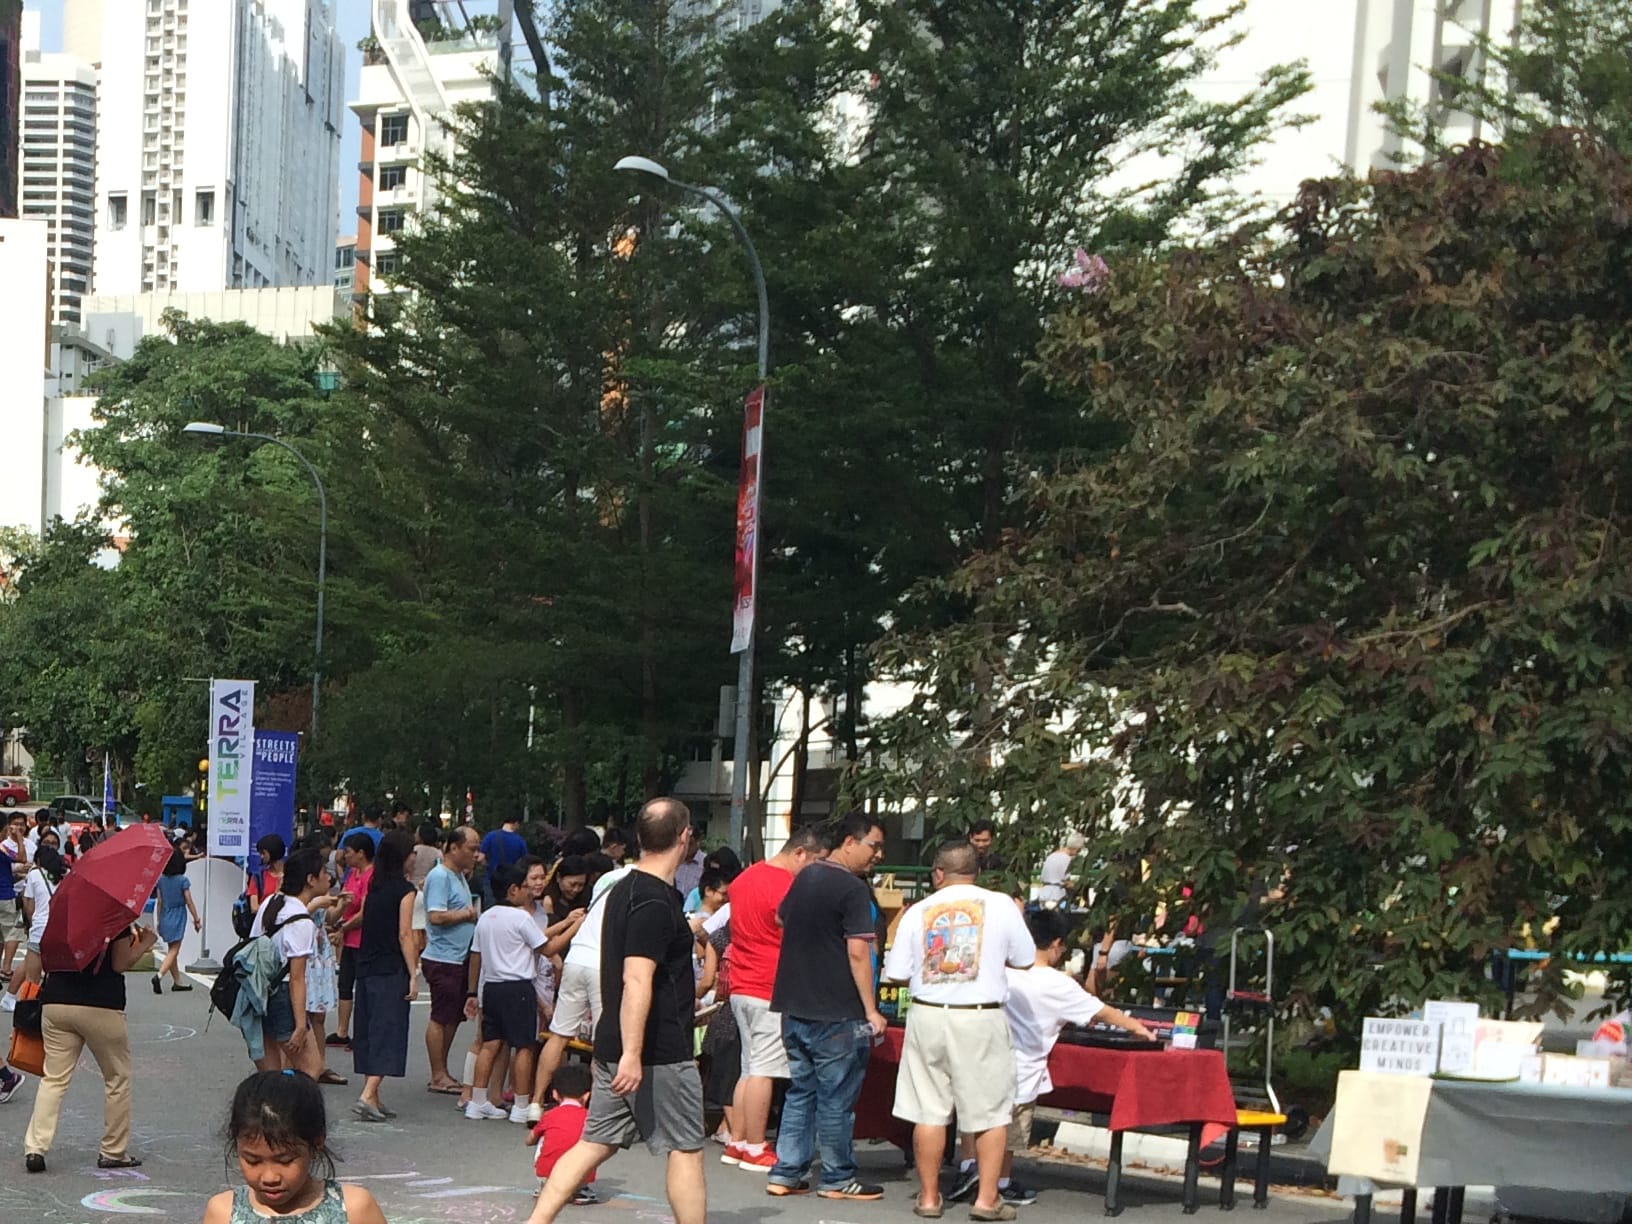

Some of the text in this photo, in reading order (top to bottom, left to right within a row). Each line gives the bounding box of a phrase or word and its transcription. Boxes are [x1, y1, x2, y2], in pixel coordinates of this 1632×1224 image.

[216, 689, 242, 802] TERRA
[256, 739, 296, 751] STREETS
[261, 752, 294, 764] PEOPLE
[1369, 1022, 1430, 1036] EMPOWER
[1363, 1039, 1433, 1055] CREATIVE
[1377, 1057, 1422, 1071] MINDS
